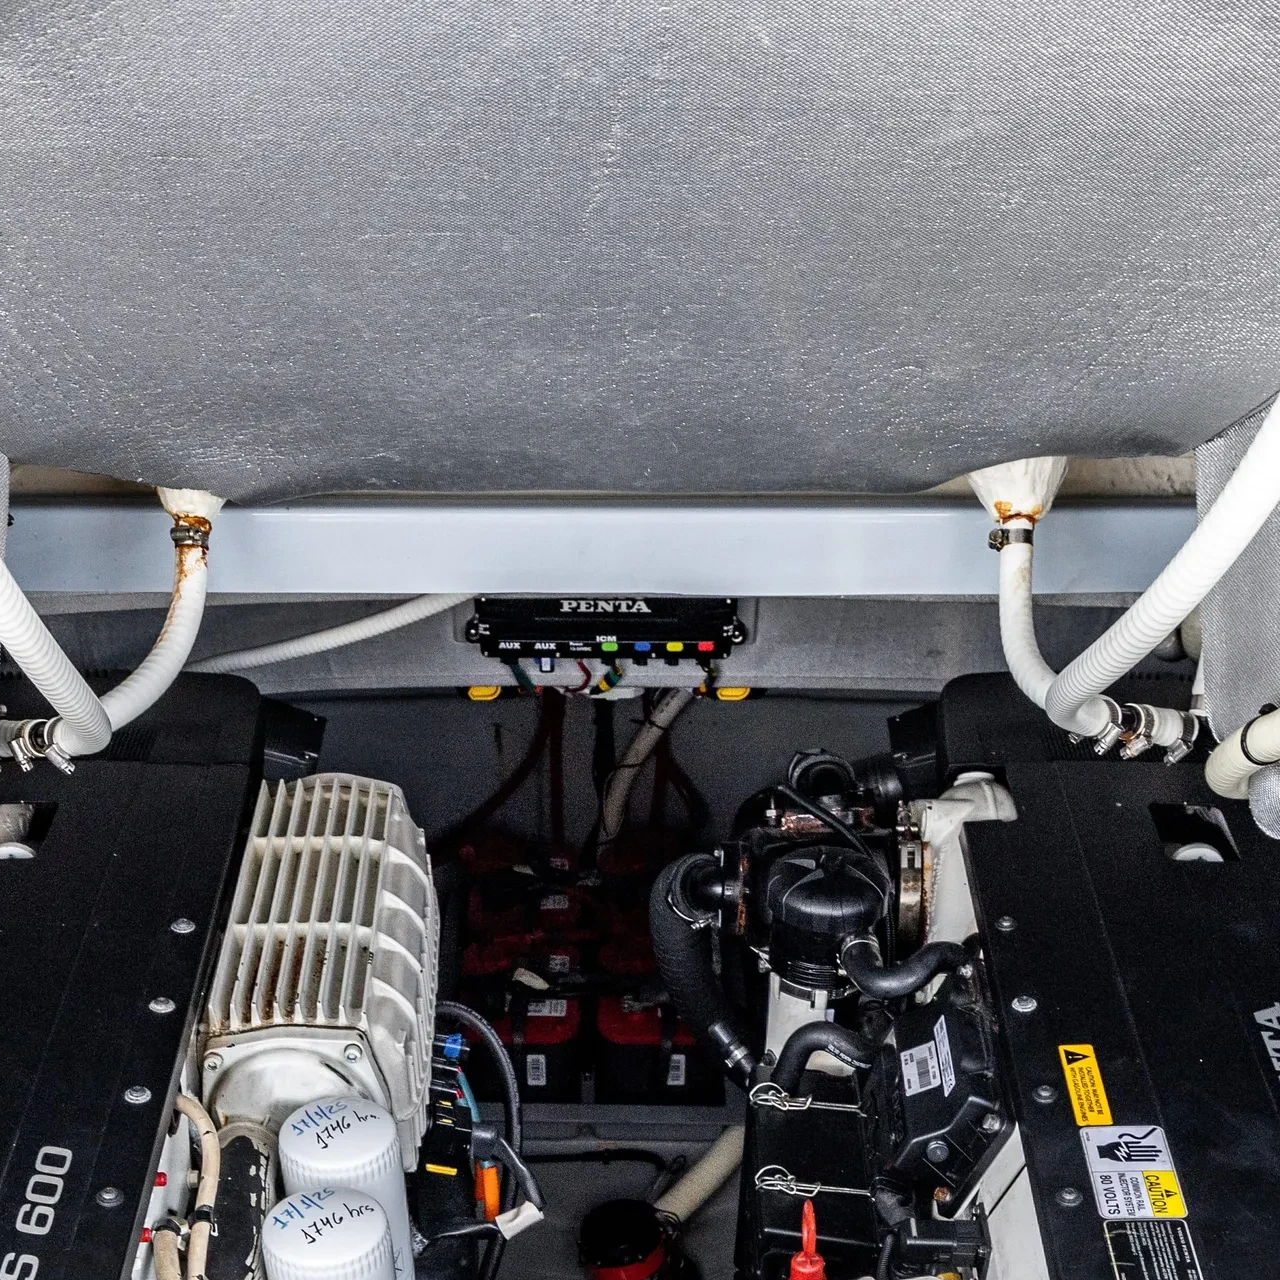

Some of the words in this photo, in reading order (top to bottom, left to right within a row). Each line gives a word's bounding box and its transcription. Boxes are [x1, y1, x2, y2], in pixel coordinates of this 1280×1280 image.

[559, 600, 652, 613] PENTA
[534, 642, 556, 650] AUX
[315, 1116, 351, 1149] 1746
[15, 1145, 73, 1235] 600
[1099, 1174, 1113, 1184] 80
[1117, 1172, 1130, 1195] INJECTOR
[1129, 1177, 1142, 1198] COMMON
[1102, 1186, 1120, 1214] VOLTS
[1135, 1199, 1145, 1211] RAIL
[1144, 1175, 1168, 1213] CAUTION
[1123, 1197, 1135, 1216] SYSTEM
[301, 1212, 344, 1244] 1746
[343, 1203, 375, 1218] hrs
